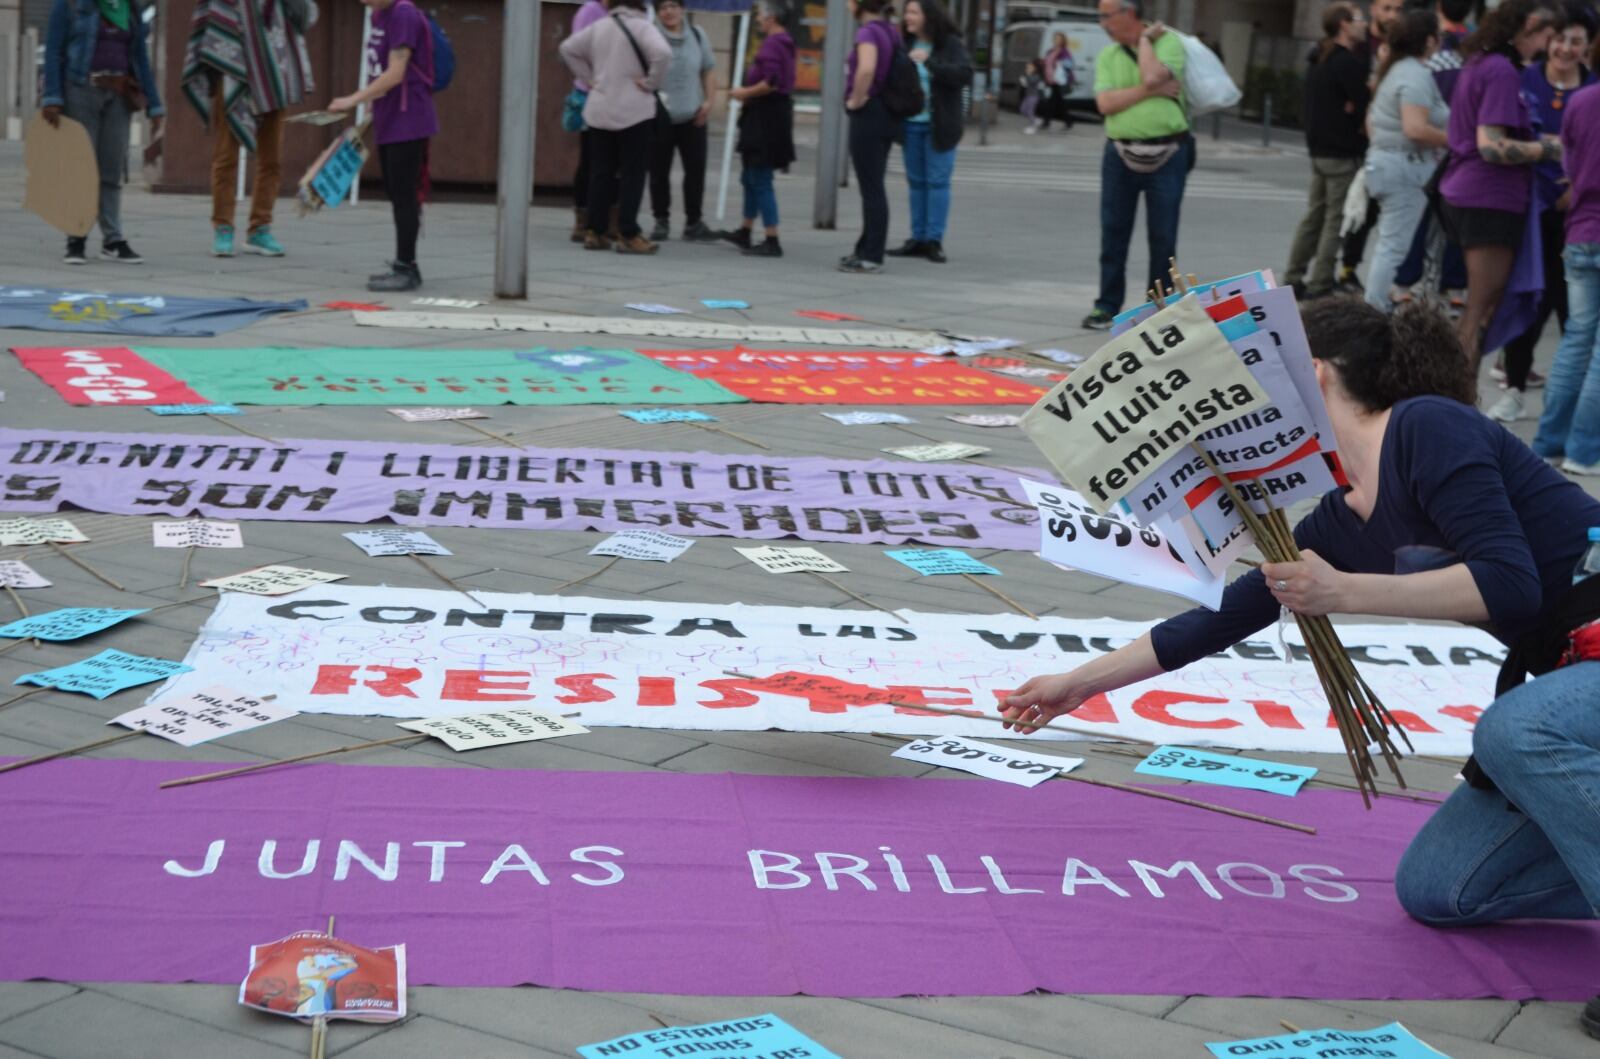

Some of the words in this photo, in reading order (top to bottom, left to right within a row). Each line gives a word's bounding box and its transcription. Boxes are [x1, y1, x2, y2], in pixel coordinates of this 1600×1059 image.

[61, 349, 157, 403] STOP
[1044, 348, 1145, 423] Visca
[1138, 320, 1186, 358] la
[1091, 366, 1191, 444] lluita
[9, 439, 301, 473] DIGNITAT
[325, 450, 348, 476] I
[381, 451, 699, 491] LLIBERTAT
[727, 463, 795, 492] DE
[1088, 382, 1255, 502] feminista
[1140, 482, 1168, 513] ni
[1169, 424, 1307, 490] maltracta
[133, 478, 338, 512] SOM
[392, 485, 980, 541] IMMIGRADES
[267, 599, 748, 638] CONTRA
[797, 623, 918, 642] LAS
[161, 706, 232, 729] OPIME
[162, 838, 625, 886] JUNTAS
[594, 1037, 642, 1058] NO
[643, 1017, 775, 1045] ESTAMOS
[655, 1038, 754, 1059] TODAS
[1227, 1039, 1285, 1057] Qui
[1292, 1031, 1399, 1050] estima
